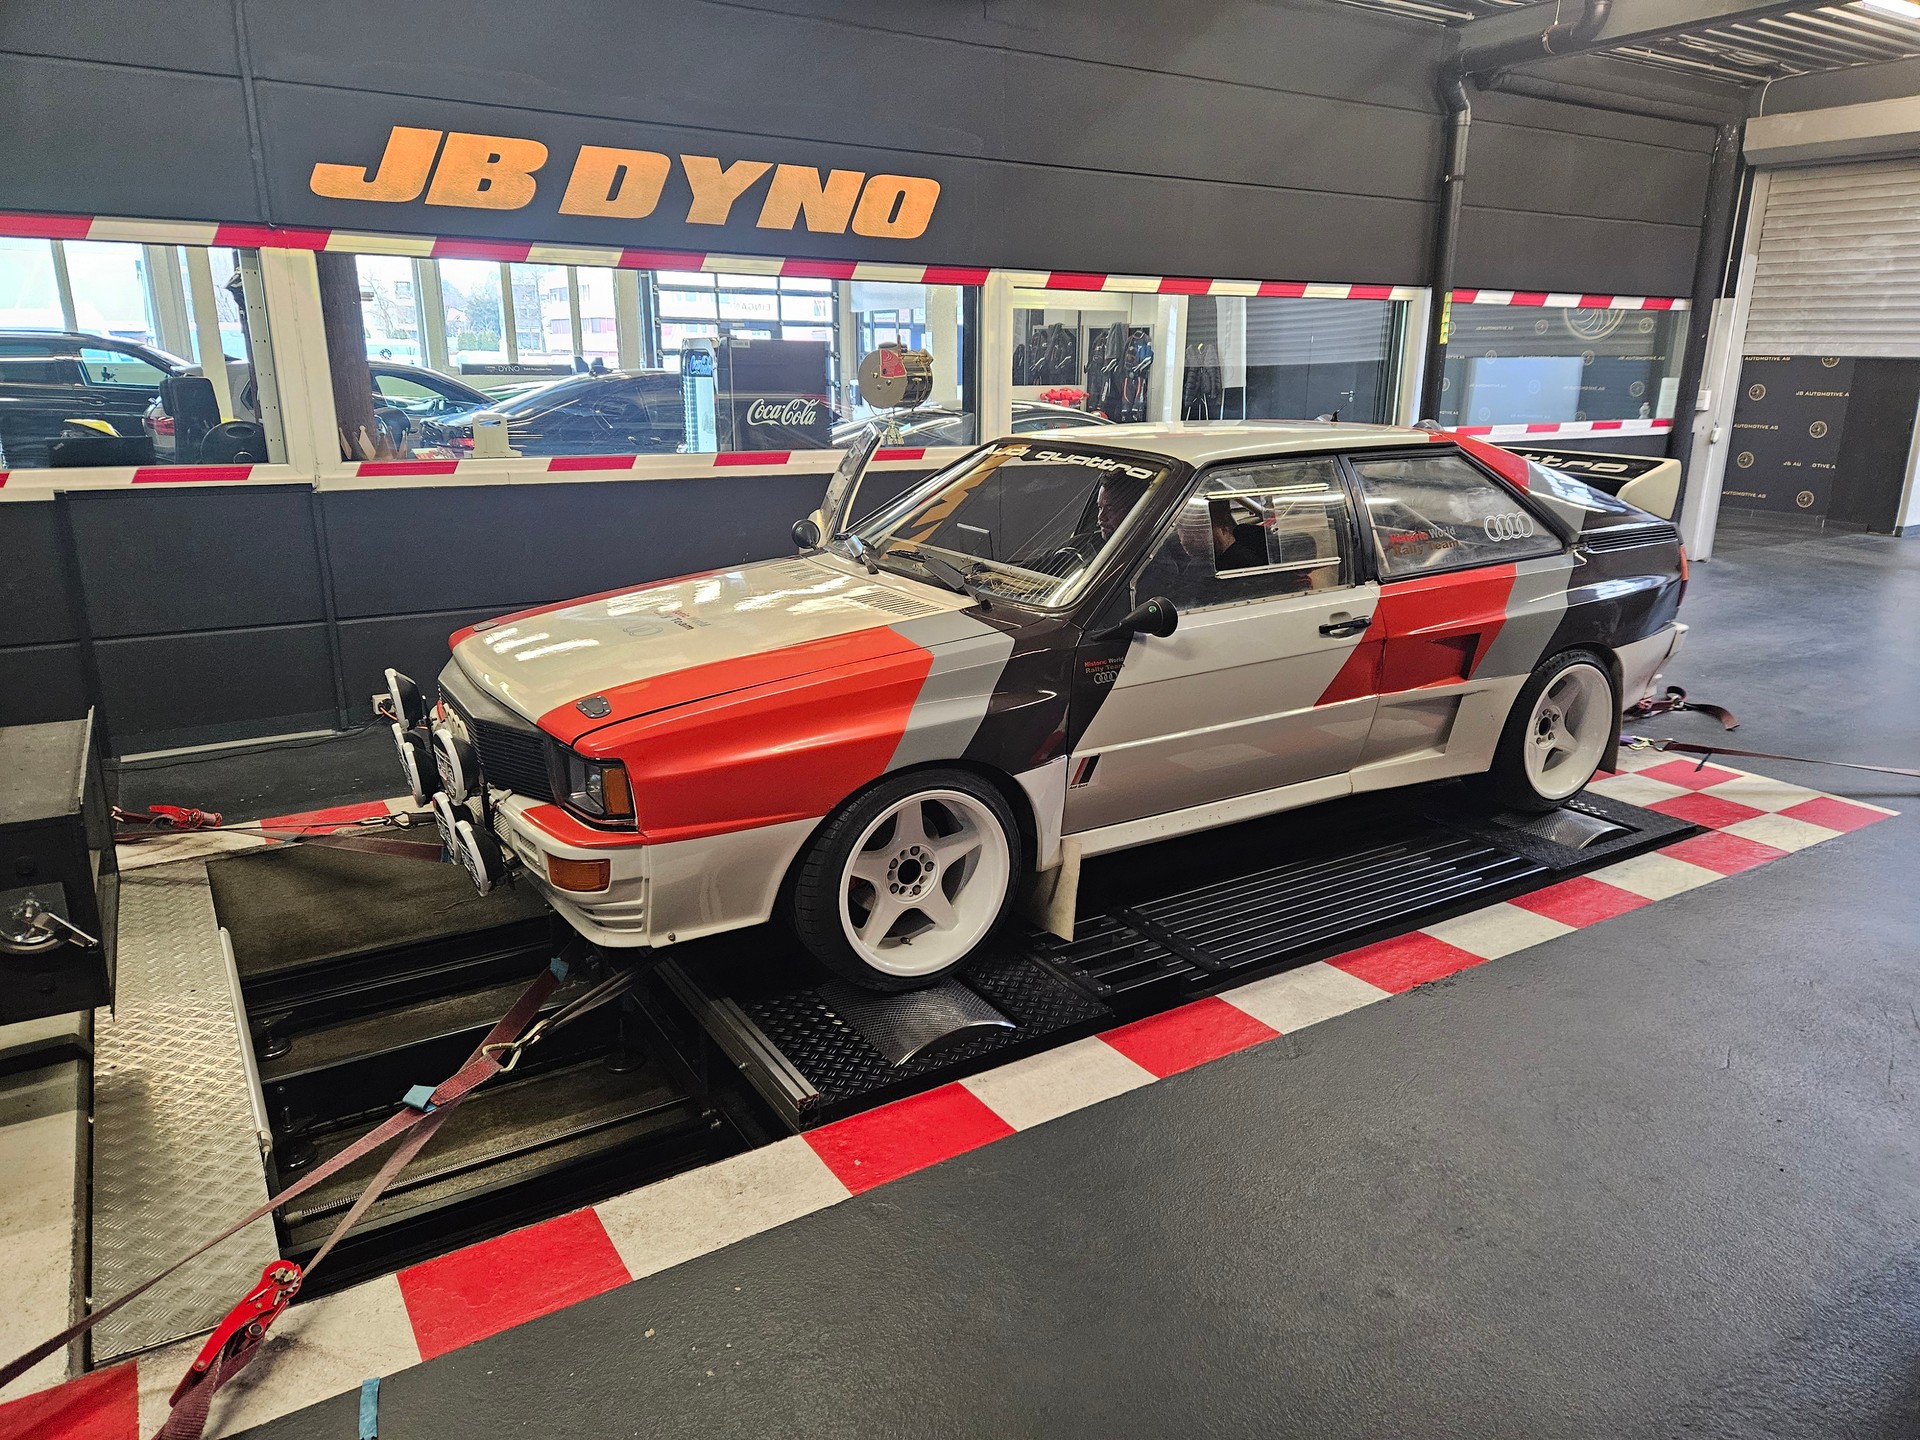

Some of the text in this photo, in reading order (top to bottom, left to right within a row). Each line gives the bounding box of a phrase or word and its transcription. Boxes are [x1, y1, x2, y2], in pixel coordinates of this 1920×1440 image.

[309, 125, 941, 239] JB DYNO
[747, 399, 820, 426] Coca-Cola
[978, 443, 1153, 480] Audi quattro
[1522, 453, 1629, 473] ttro
[1428, 526, 1456, 539] World
[1393, 539, 1459, 556] Rally Team
